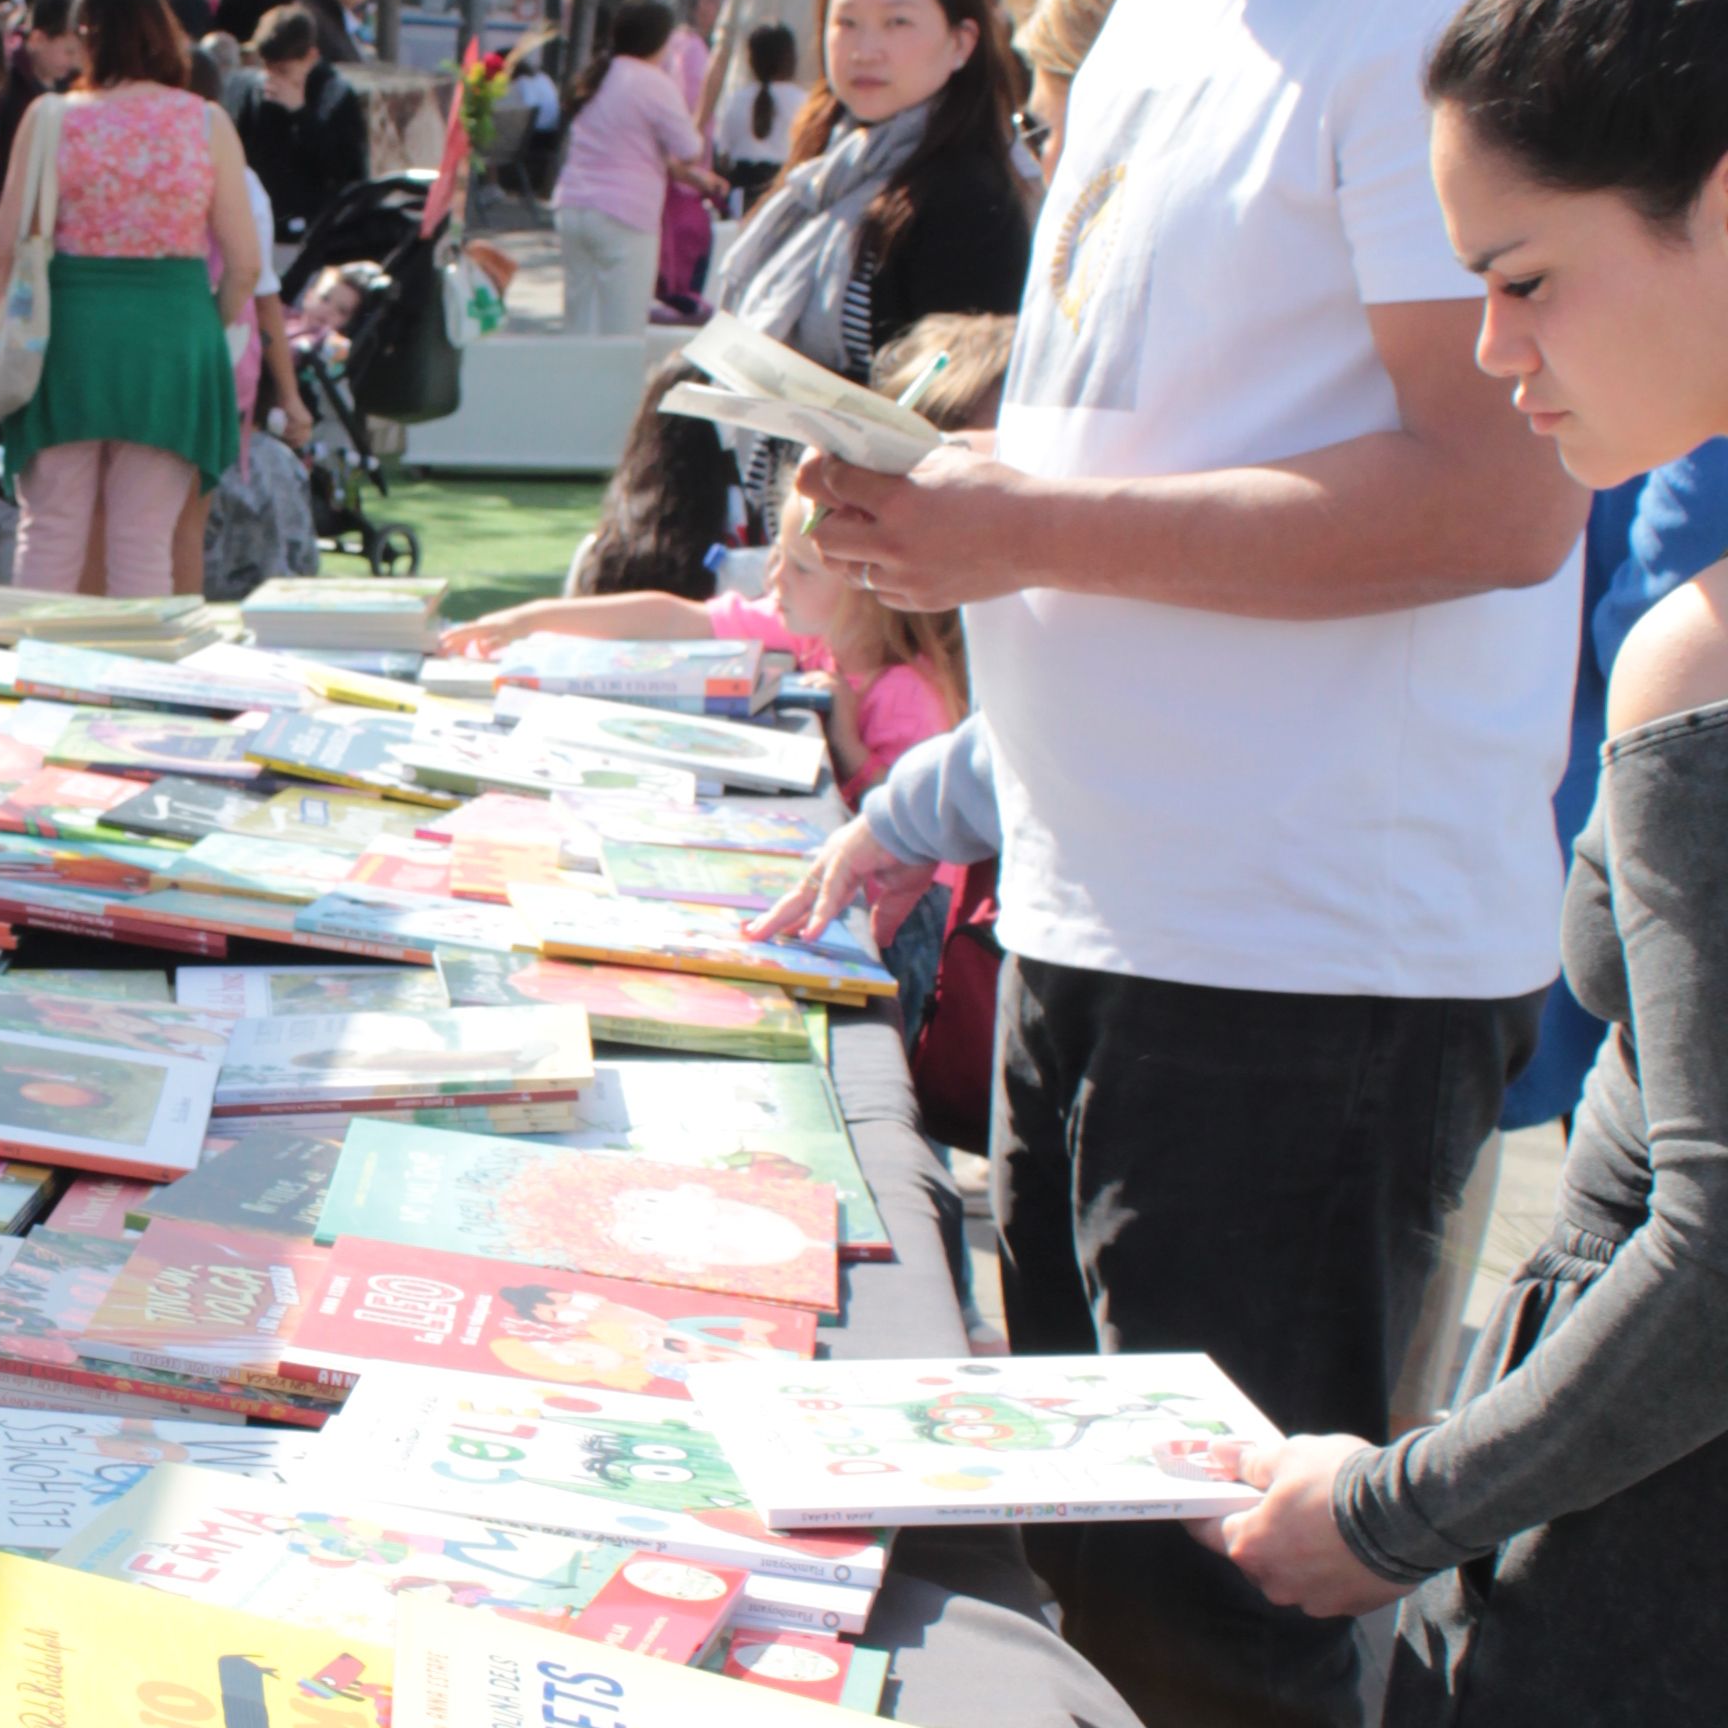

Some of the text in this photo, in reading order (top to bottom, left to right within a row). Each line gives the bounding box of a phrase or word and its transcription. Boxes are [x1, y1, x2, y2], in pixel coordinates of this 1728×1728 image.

[144, 1286, 198, 1324] TINC
[0, 1418, 83, 1530] ELS HOMES
[488, 1653, 521, 1690] DELS
